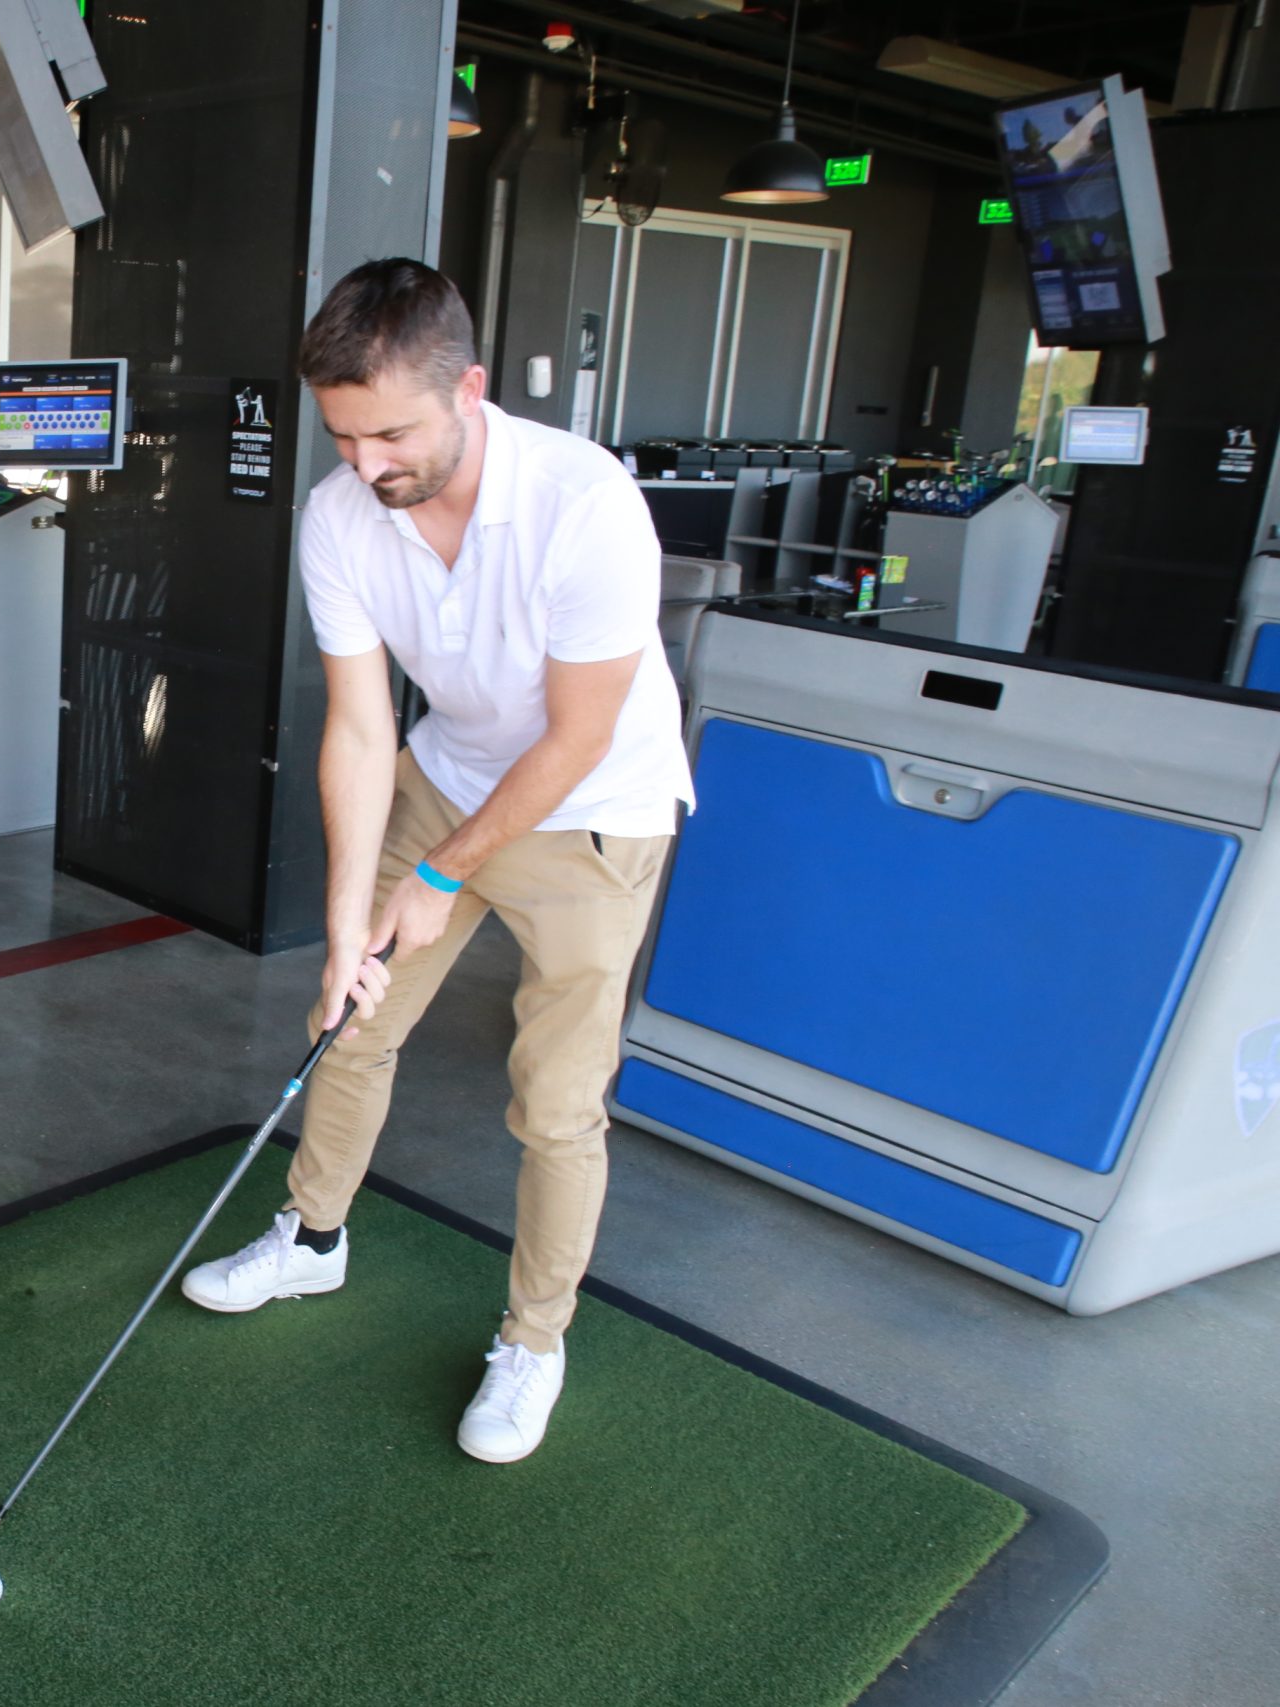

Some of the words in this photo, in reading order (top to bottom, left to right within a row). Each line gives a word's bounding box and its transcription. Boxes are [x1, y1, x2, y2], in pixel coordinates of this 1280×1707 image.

[232, 431, 271, 442] SPECTATORS
[240, 443, 262, 452] PLEASE
[231, 453, 246, 462] STAY
[247, 454, 271, 464] BEHIND
[230, 463, 248, 475] RED
[249, 464, 270, 477] LINE
